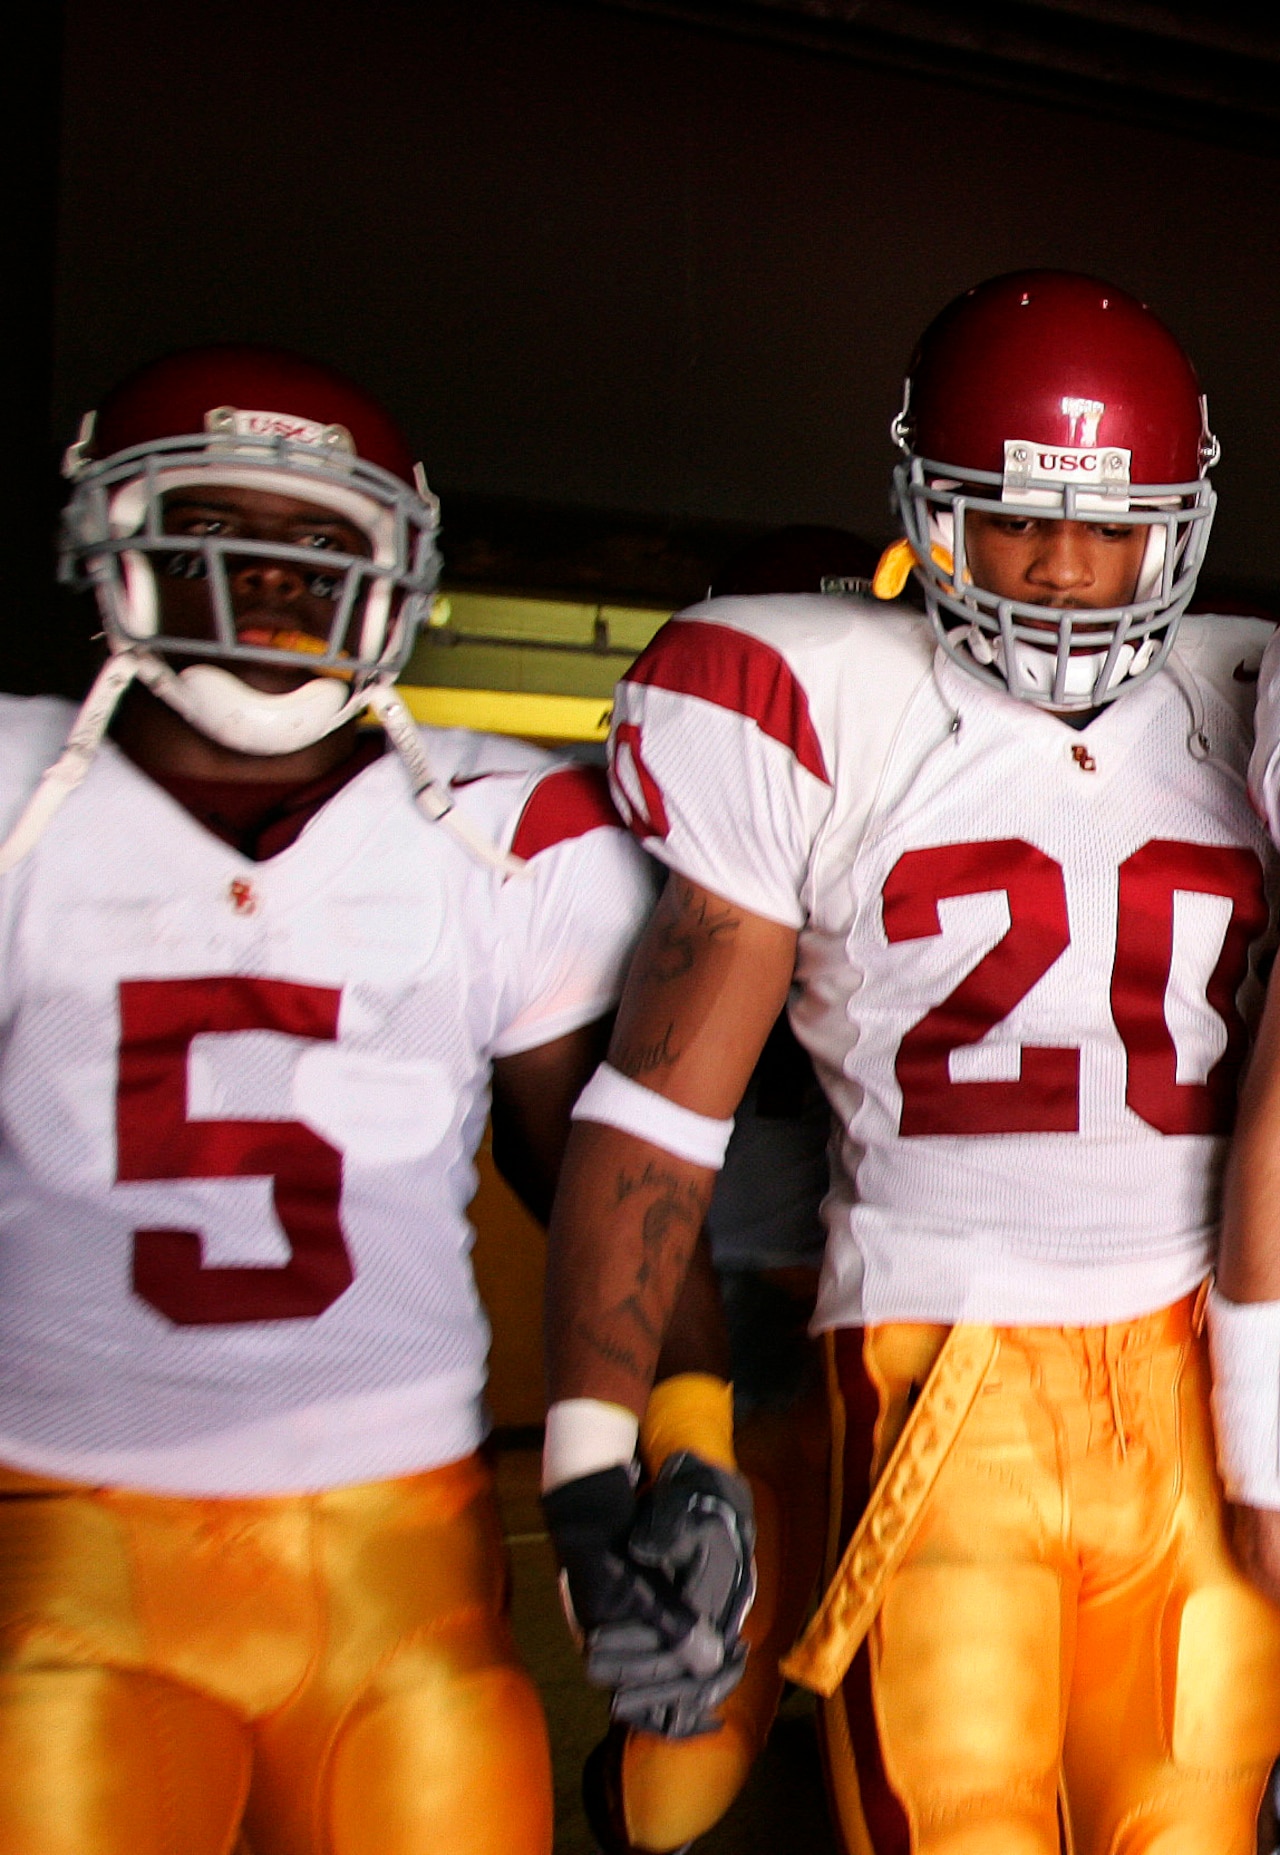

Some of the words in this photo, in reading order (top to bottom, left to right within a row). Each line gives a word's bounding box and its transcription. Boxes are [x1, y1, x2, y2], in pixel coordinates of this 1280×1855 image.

[1038, 453, 1097, 471] USC
[882, 838, 1270, 1137] 20
[115, 976, 355, 1327] 5
